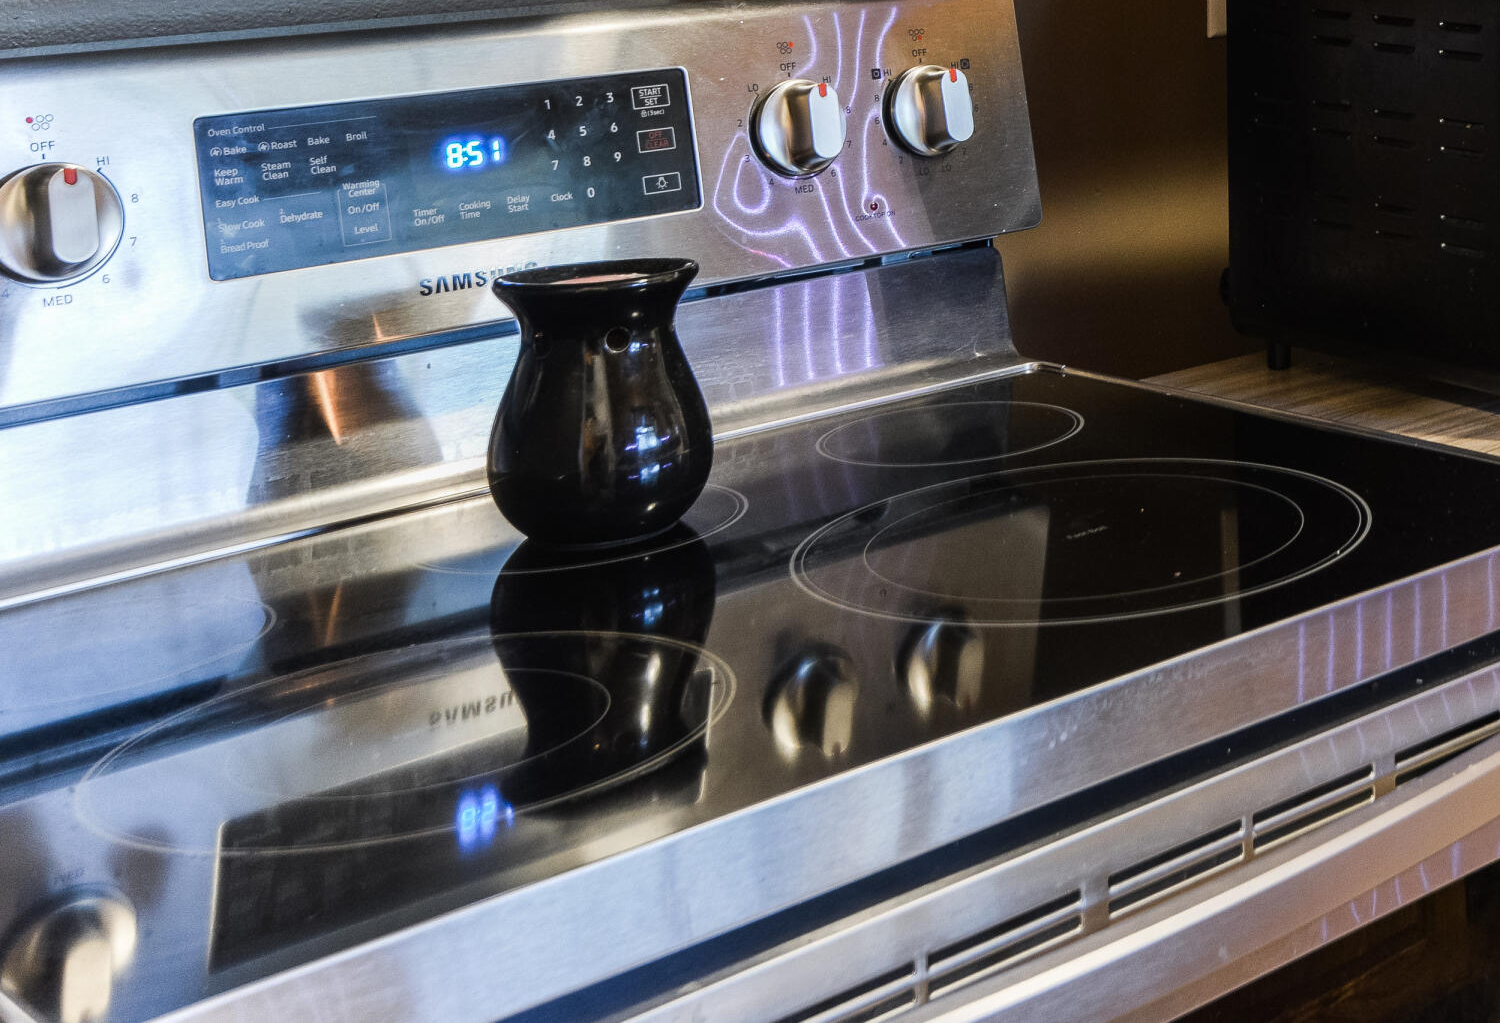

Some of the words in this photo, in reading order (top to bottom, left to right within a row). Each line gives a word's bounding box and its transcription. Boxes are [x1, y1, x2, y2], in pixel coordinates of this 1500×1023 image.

[912, 49, 927, 57] OFF
[780, 62, 796, 71] OFF
[638, 88, 661, 96] START
[747, 84, 759, 93] LO
[544, 99, 551, 109] 1
[575, 96, 583, 107] 2
[606, 92, 614, 103] 3
[644, 98, 658, 106] SET
[737, 119, 743, 127] 2
[208, 128, 231, 137] Oven
[233, 123, 265, 135] Control
[548, 129, 556, 140] 4
[579, 126, 587, 137] 5
[610, 122, 618, 133] 6
[649, 130, 663, 138] OFF
[30, 140, 56, 152] OFF
[224, 146, 247, 156] Bake
[271, 140, 297, 150] Roast
[308, 136, 330, 146] Bake
[346, 131, 368, 141] Broil
[645, 139, 670, 149] CLEAR
[446, 140, 500, 168] 8:51
[96, 156, 110, 166] HI
[309, 155, 328, 165] Self
[551, 160, 559, 171] 7
[583, 156, 591, 167] 8
[614, 151, 622, 162] 9
[261, 161, 291, 172] Steam
[311, 164, 337, 175] Clean
[214, 168, 238, 177] Keep
[263, 170, 289, 181] Clean
[215, 176, 244, 186] Warm
[342, 179, 380, 190] Warming
[348, 188, 377, 198] Center
[587, 187, 595, 198] 0
[795, 184, 814, 194] MED
[131, 193, 139, 203] 8
[215, 200, 236, 209] Easy
[238, 195, 260, 205] Cook
[507, 195, 530, 206] Delay
[551, 192, 573, 202] Clock
[347, 202, 380, 214] On/Off
[459, 200, 491, 211] Cooking
[508, 203, 529, 213] Start
[280, 210, 323, 224] Dehydrate
[413, 207, 438, 217] Timer
[460, 210, 481, 219] Time
[242, 219, 265, 228] Cook
[414, 214, 445, 227] On/Off
[354, 224, 378, 235] Level
[130, 237, 137, 247] 7
[220, 243, 245, 254] Bread
[247, 239, 269, 249] Proof
[103, 274, 110, 284] 6
[43, 294, 73, 307] MED
